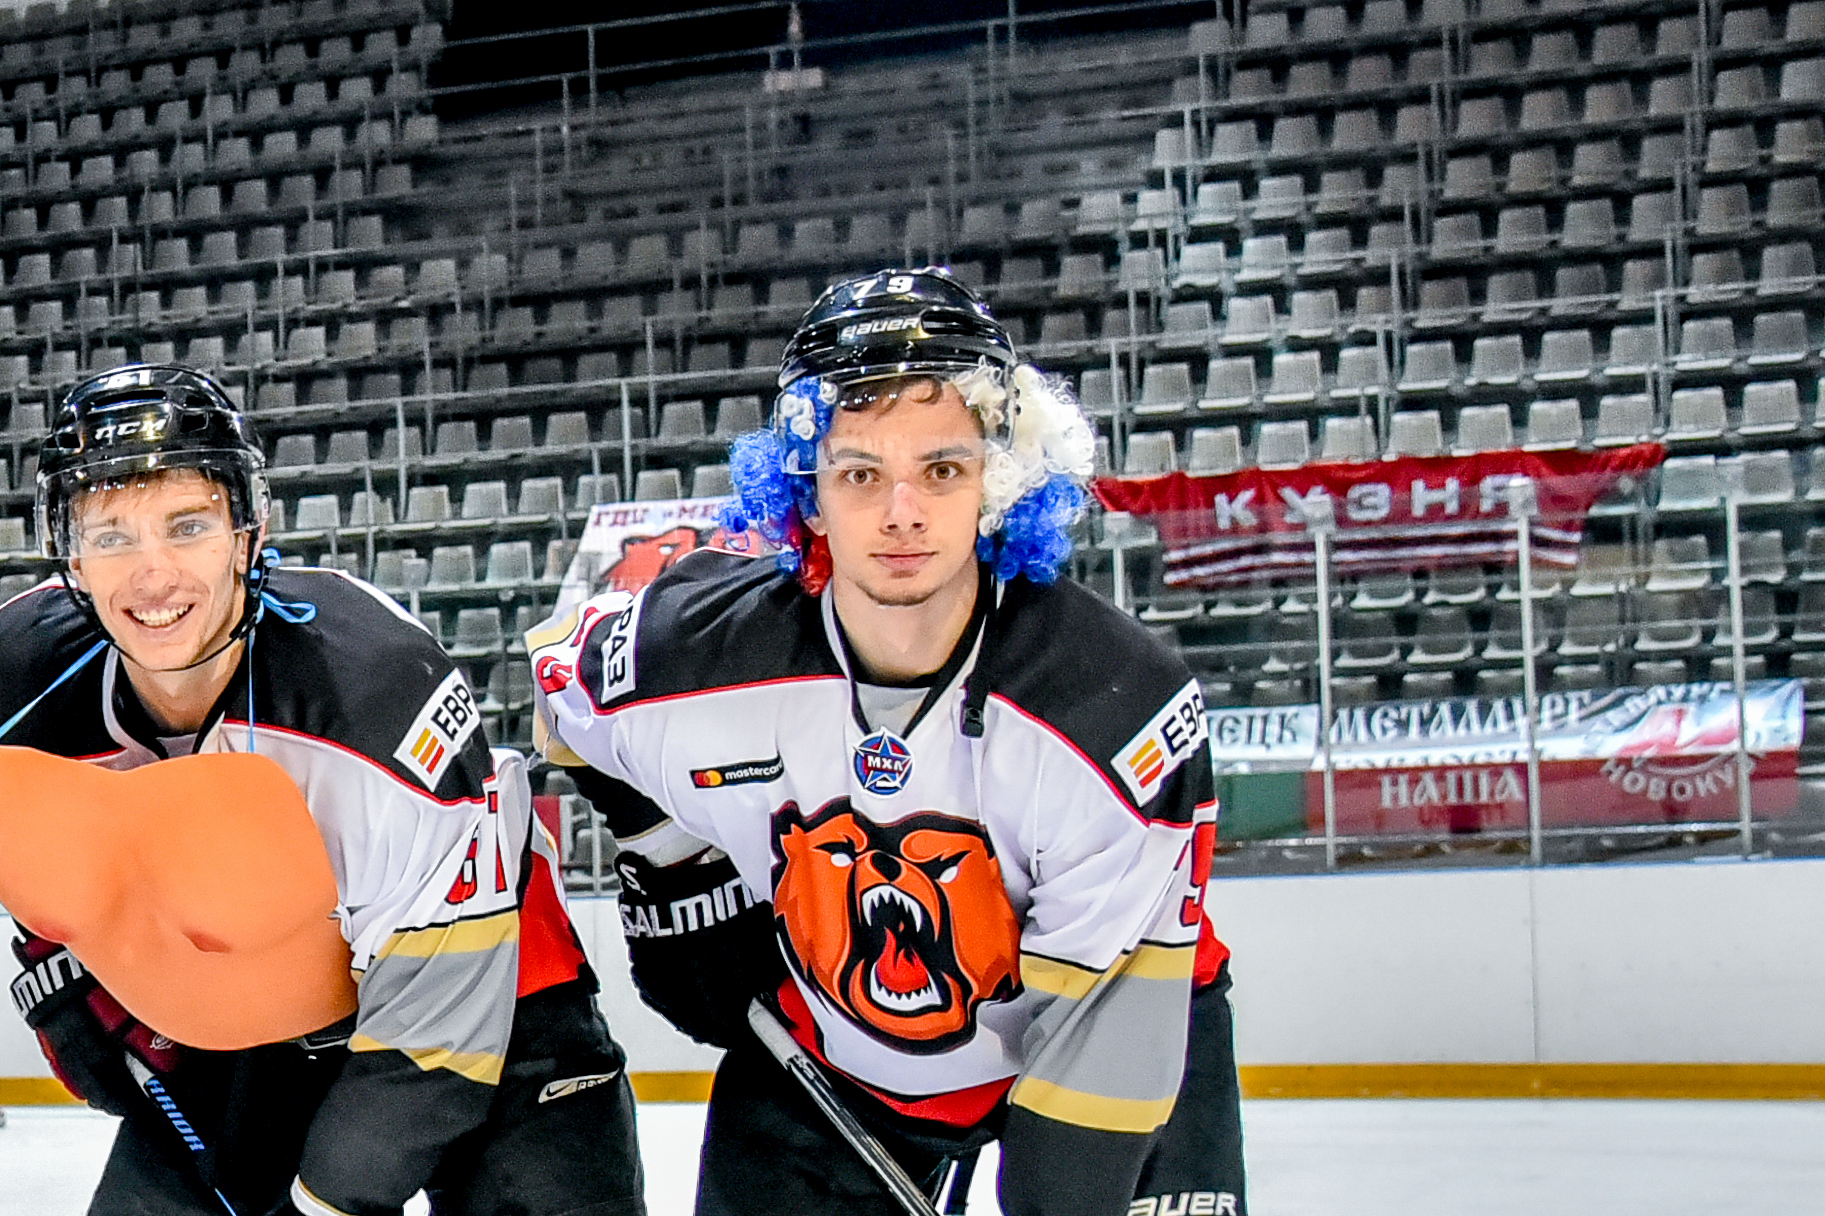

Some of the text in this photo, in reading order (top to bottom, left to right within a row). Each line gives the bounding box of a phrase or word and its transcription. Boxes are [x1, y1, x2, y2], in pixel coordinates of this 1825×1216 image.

[852, 275, 915, 301] 79
[607, 600, 633, 688] РАЗ
[1209, 709, 1300, 750] ЕЦК
